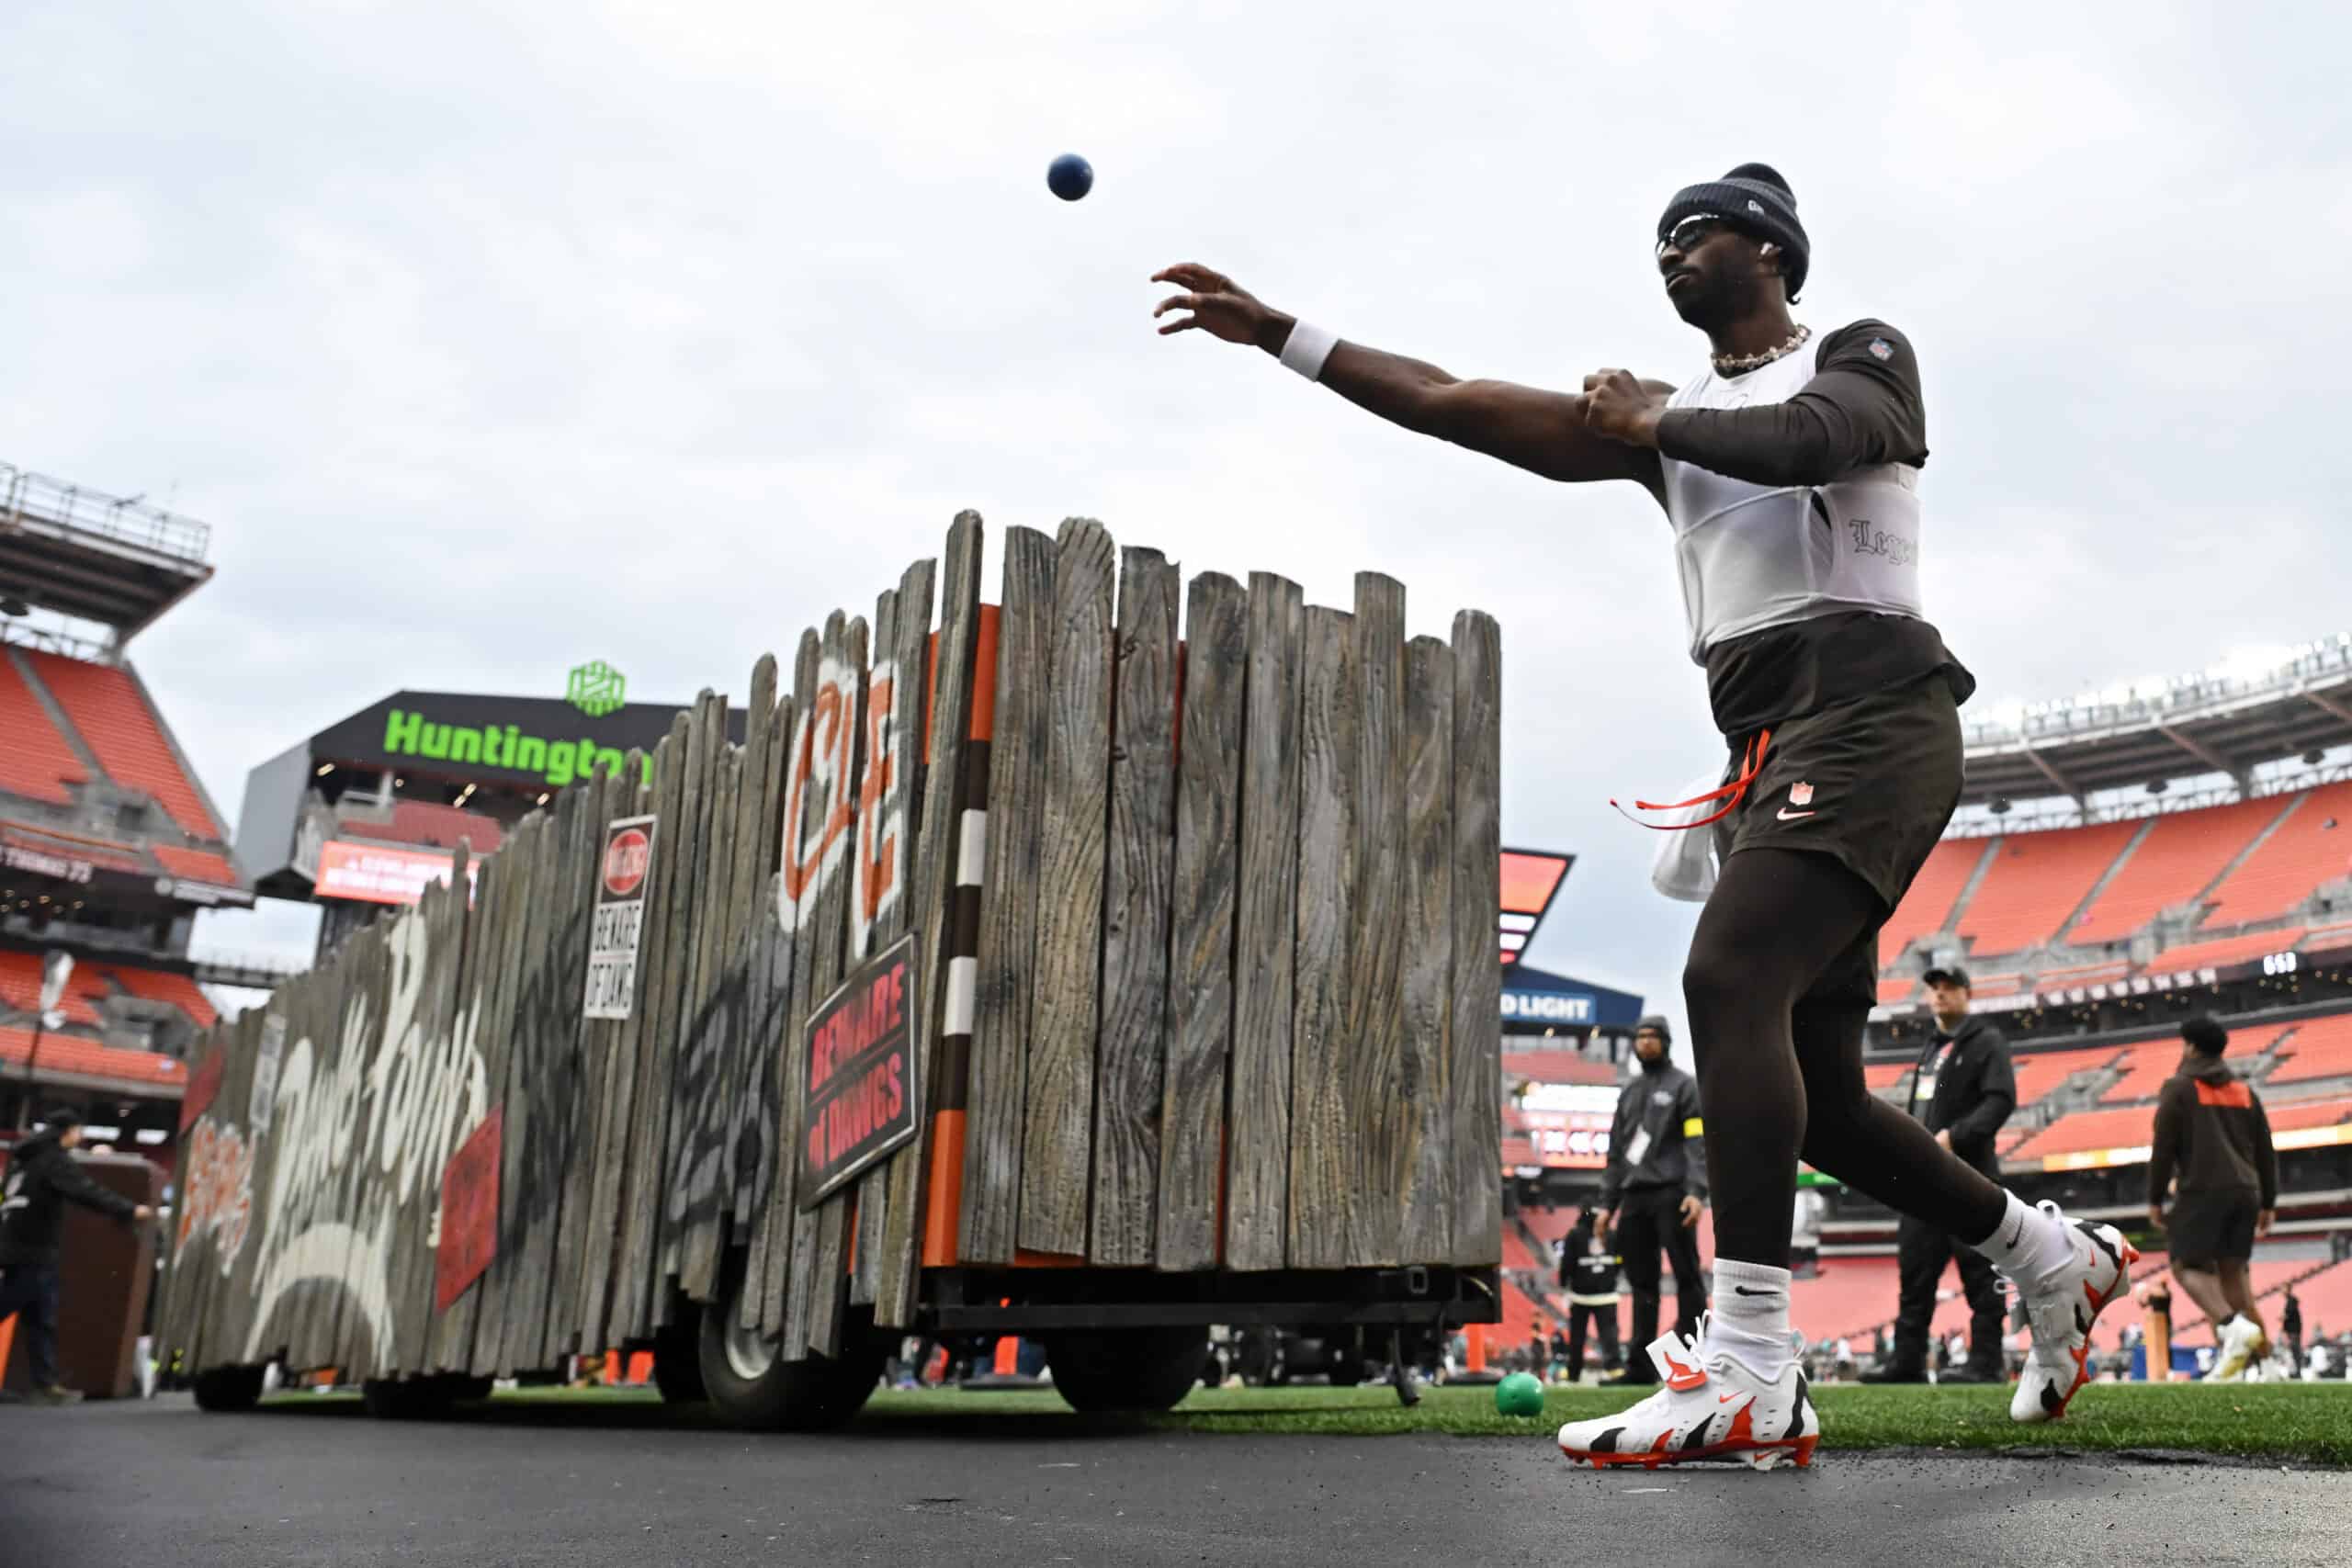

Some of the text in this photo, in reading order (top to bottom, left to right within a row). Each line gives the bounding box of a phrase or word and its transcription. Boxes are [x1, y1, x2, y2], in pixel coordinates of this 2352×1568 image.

[595, 905, 640, 952] BEWARE
[809, 962, 905, 1092] BEWARE
[1520, 994, 1590, 1021] LIGHT
[828, 1053, 903, 1164] DAWGS
